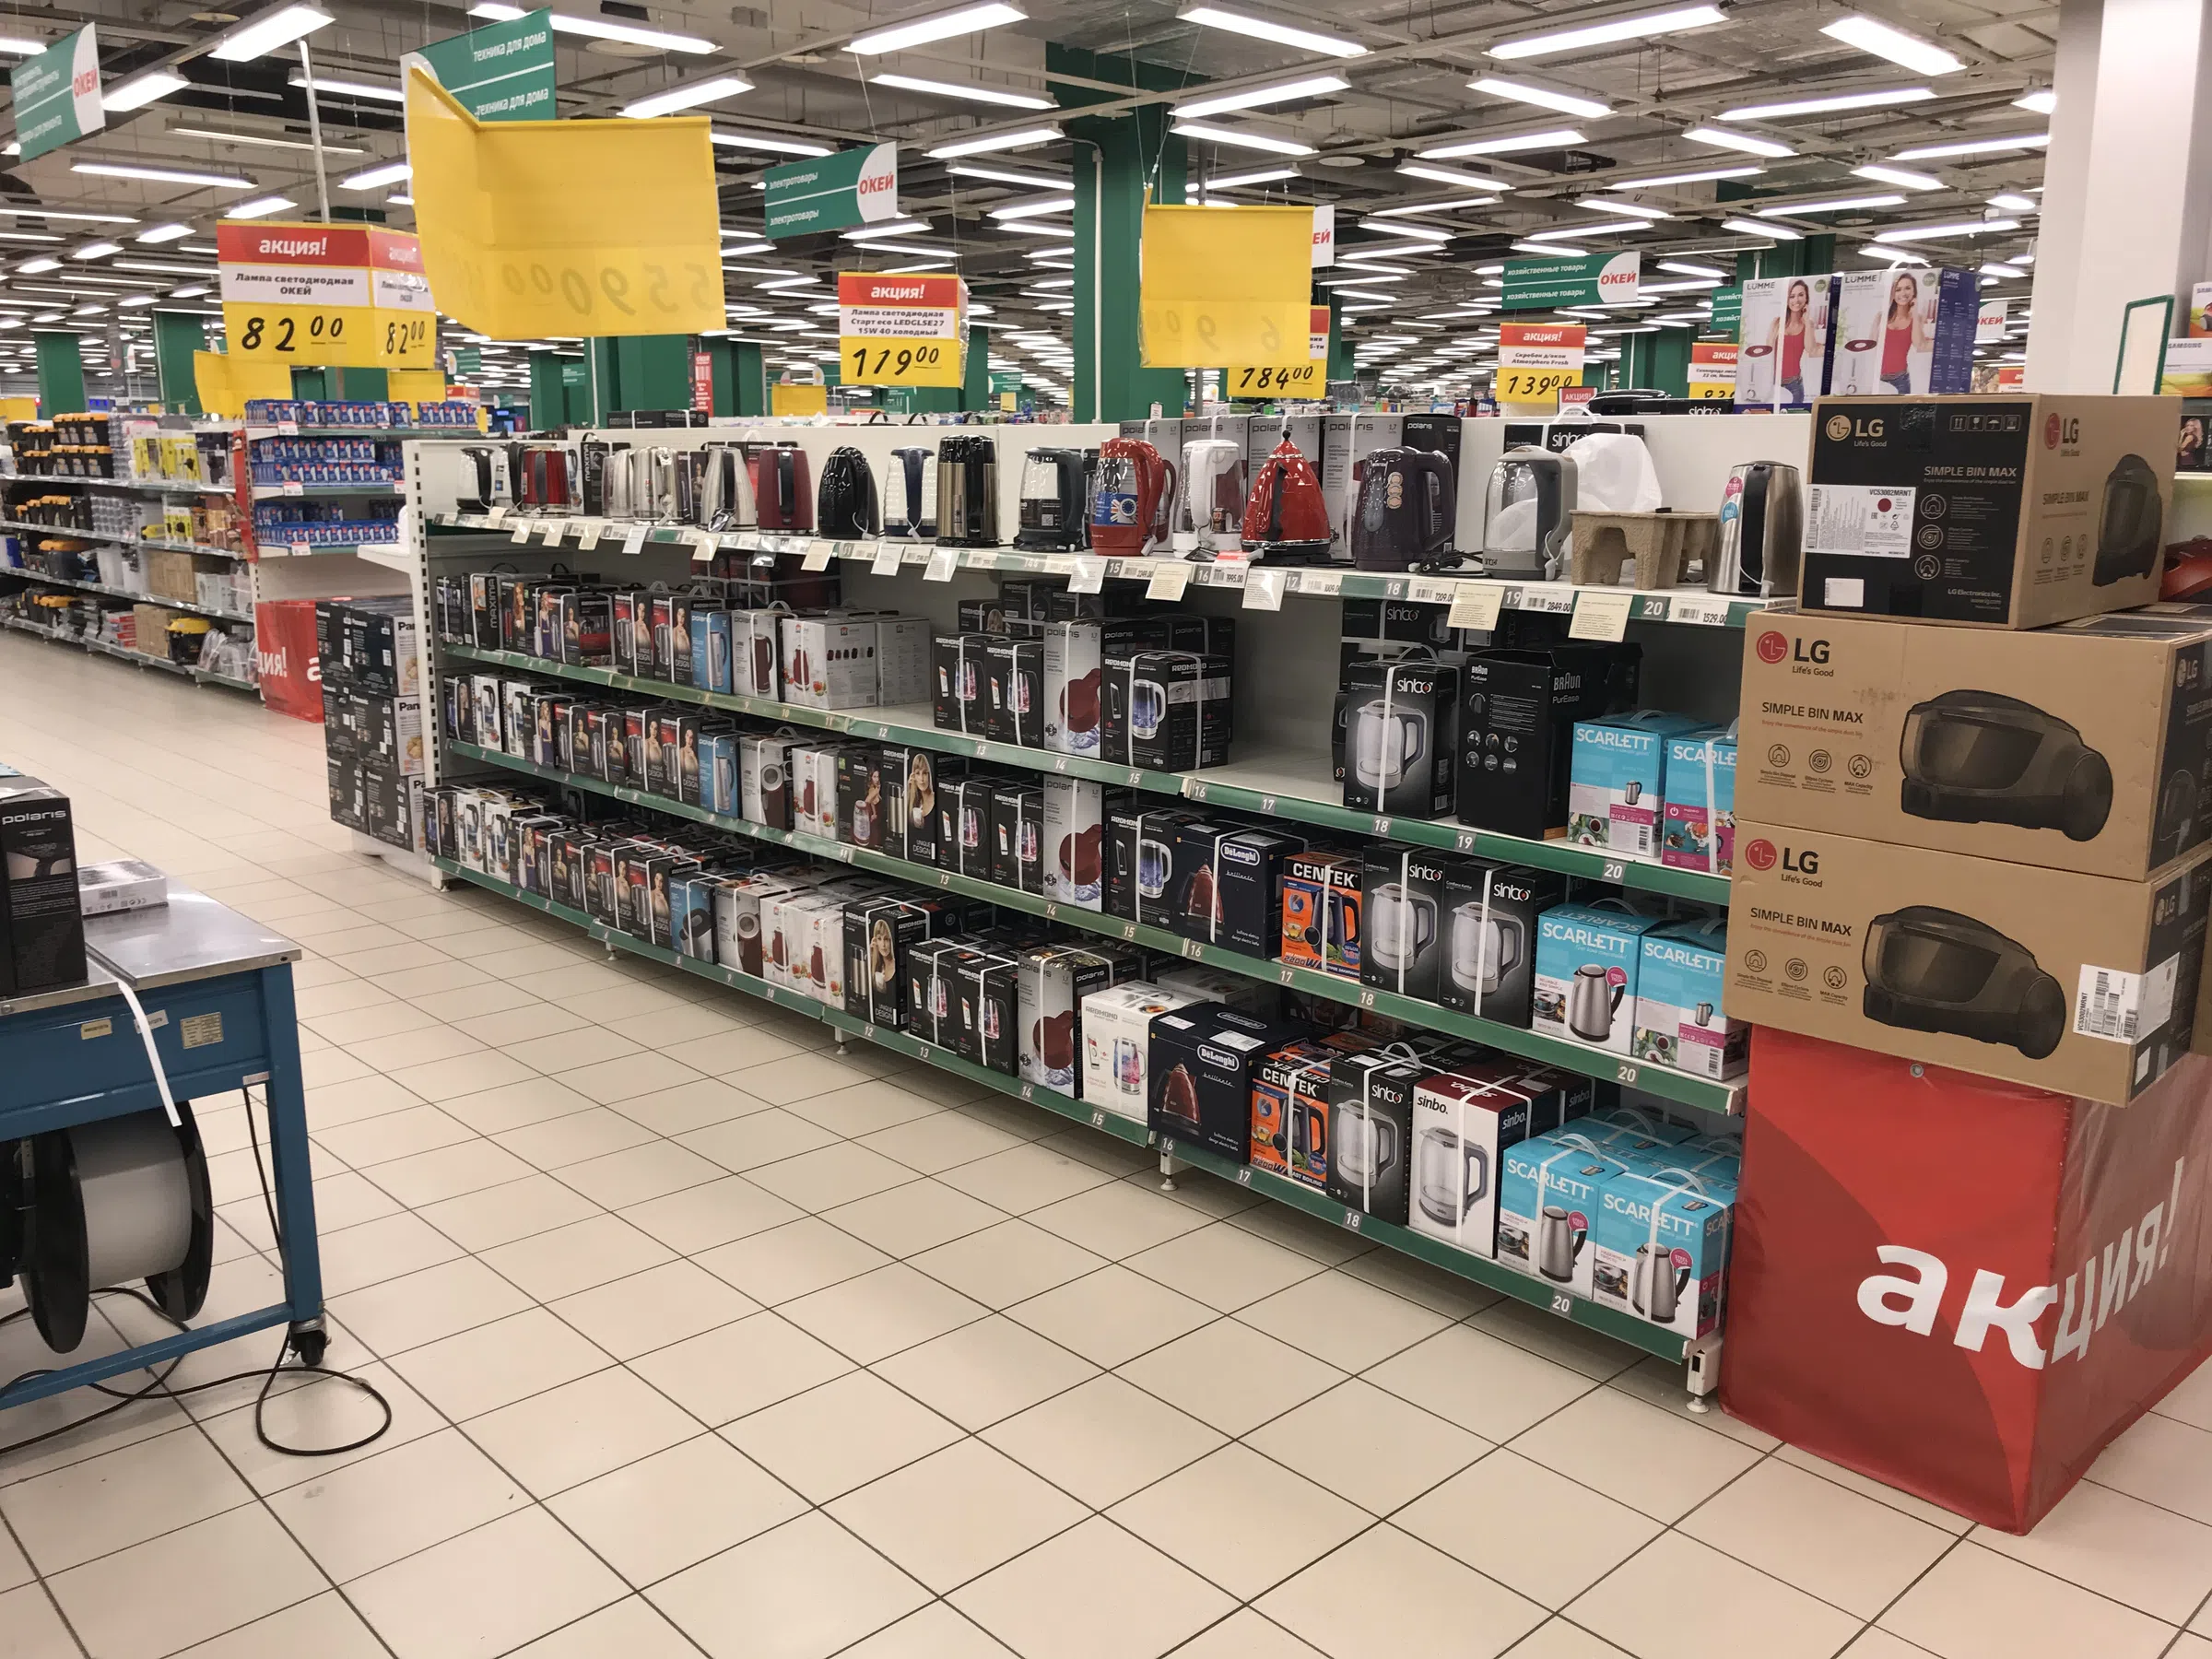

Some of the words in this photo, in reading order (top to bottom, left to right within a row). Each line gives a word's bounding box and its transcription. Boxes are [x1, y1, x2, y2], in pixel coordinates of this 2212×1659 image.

[474, 41, 505, 63] техника
[506, 40, 522, 55] для
[523, 30, 547, 51] дома
[476, 100, 508, 116] техника
[509, 96, 524, 112] для
[525, 88, 548, 108] дома
[769, 172, 818, 191] электротовары
[770, 209, 819, 227] электротовары
[259, 237, 326, 256] акция!
[1507, 265, 1559, 276] хозяйственные
[1560, 263, 1587, 274] товары
[236, 273, 272, 282] Лампа
[275, 276, 354, 285] светодиодная
[1747, 281, 1775, 290] LUMME
[1844, 275, 1877, 284] LUMME
[280, 286, 312, 296] ОКЕЙ
[870, 285, 924, 300] акция!
[1506, 290, 1559, 301] хозяйственные
[1559, 288, 1585, 299] товары
[851, 309, 880, 317] Лампа
[881, 310, 945, 318] светодиодная
[1716, 315, 1740, 324] хозяйст
[892, 328, 938, 337] холодный
[1523, 330, 1562, 343] акция!
[1712, 351, 1737, 360] акци
[1855, 418, 1884, 438] LG
[2062, 418, 2079, 444] LG
[1924, 466, 1964, 477] SIMPLE
[1966, 467, 1986, 477] BIN
[1989, 468, 2017, 477] MAX
[1109, 562, 1121, 573] 15
[1198, 570, 1208, 582] 16
[1286, 576, 1298, 588] 17
[1386, 582, 1401, 595] 18
[1506, 591, 1521, 604] 19
[1644, 601, 1663, 615] 20
[1794, 638, 1830, 664] LG
[1471, 665, 1488, 675] BRAUN
[1792, 665, 1811, 675] Life's
[1814, 668, 1834, 677] Good
[1396, 677, 1433, 694] sinbo
[1553, 672, 1581, 691] BRAUN
[1552, 694, 1580, 704] PurEase
[1762, 702, 1805, 717] SIMPLE
[1808, 707, 1830, 720] BIN
[1832, 711, 1864, 724] MAX
[1576, 728, 1651, 750] SCARLETT
[976, 746, 986, 755] 13
[1673, 746, 1736, 766] SCARLE
[1054, 759, 1065, 770] 14
[1129, 773, 1140, 783] 15
[1194, 785, 1206, 797] 16
[1262, 798, 1275, 810] 17
[2, 809, 66, 825] polaris
[1374, 819, 1389, 833] 18
[1457, 835, 1473, 849] 19
[912, 844, 931, 855] DESIGN
[1223, 846, 1257, 862] DeLonghi
[1783, 847, 1818, 874] LG
[1292, 863, 1355, 888] CENTEK
[1409, 864, 1441, 881] sinbo
[1604, 864, 1623, 879] 20
[940, 875, 948, 885] 13
[1782, 874, 1800, 884] Life's
[1803, 877, 1823, 888] Good
[1493, 882, 1530, 901] sinbo
[1047, 905, 1056, 916] 14
[1750, 907, 1794, 925] SIMPLE
[1797, 916, 1818, 930] BIN
[1821, 921, 1852, 936] MAX
[1124, 926, 1135, 937] 15
[1542, 922, 1630, 953] SCARLETT
[1190, 944, 1201, 956] 16
[1644, 943, 1725, 972] SCARLETT
[1076, 970, 1104, 982] polaris
[1281, 970, 1293, 982] 17
[1360, 993, 1374, 1005] 18
[864, 1026, 873, 1037] 12
[920, 1047, 928, 1058] 13
[1201, 1049, 1236, 1068] DeLonghi
[1618, 1066, 1636, 1082] 20
[1262, 1067, 1316, 1097] CENTEK
[1021, 1086, 1031, 1098] 14
[1371, 1083, 1404, 1105] sinbo
[1417, 1094, 1448, 1114] sinbo.
[1092, 1112, 1103, 1124] 15
[1161, 1138, 1173, 1150] 16
[1238, 1170, 1251, 1182] 17
[1507, 1159, 1590, 1199] SCARLETT
[1346, 1213, 1359, 1227] 18
[1857, 1156, 2184, 1370] акция!
[1552, 1296, 1570, 1312] 20
